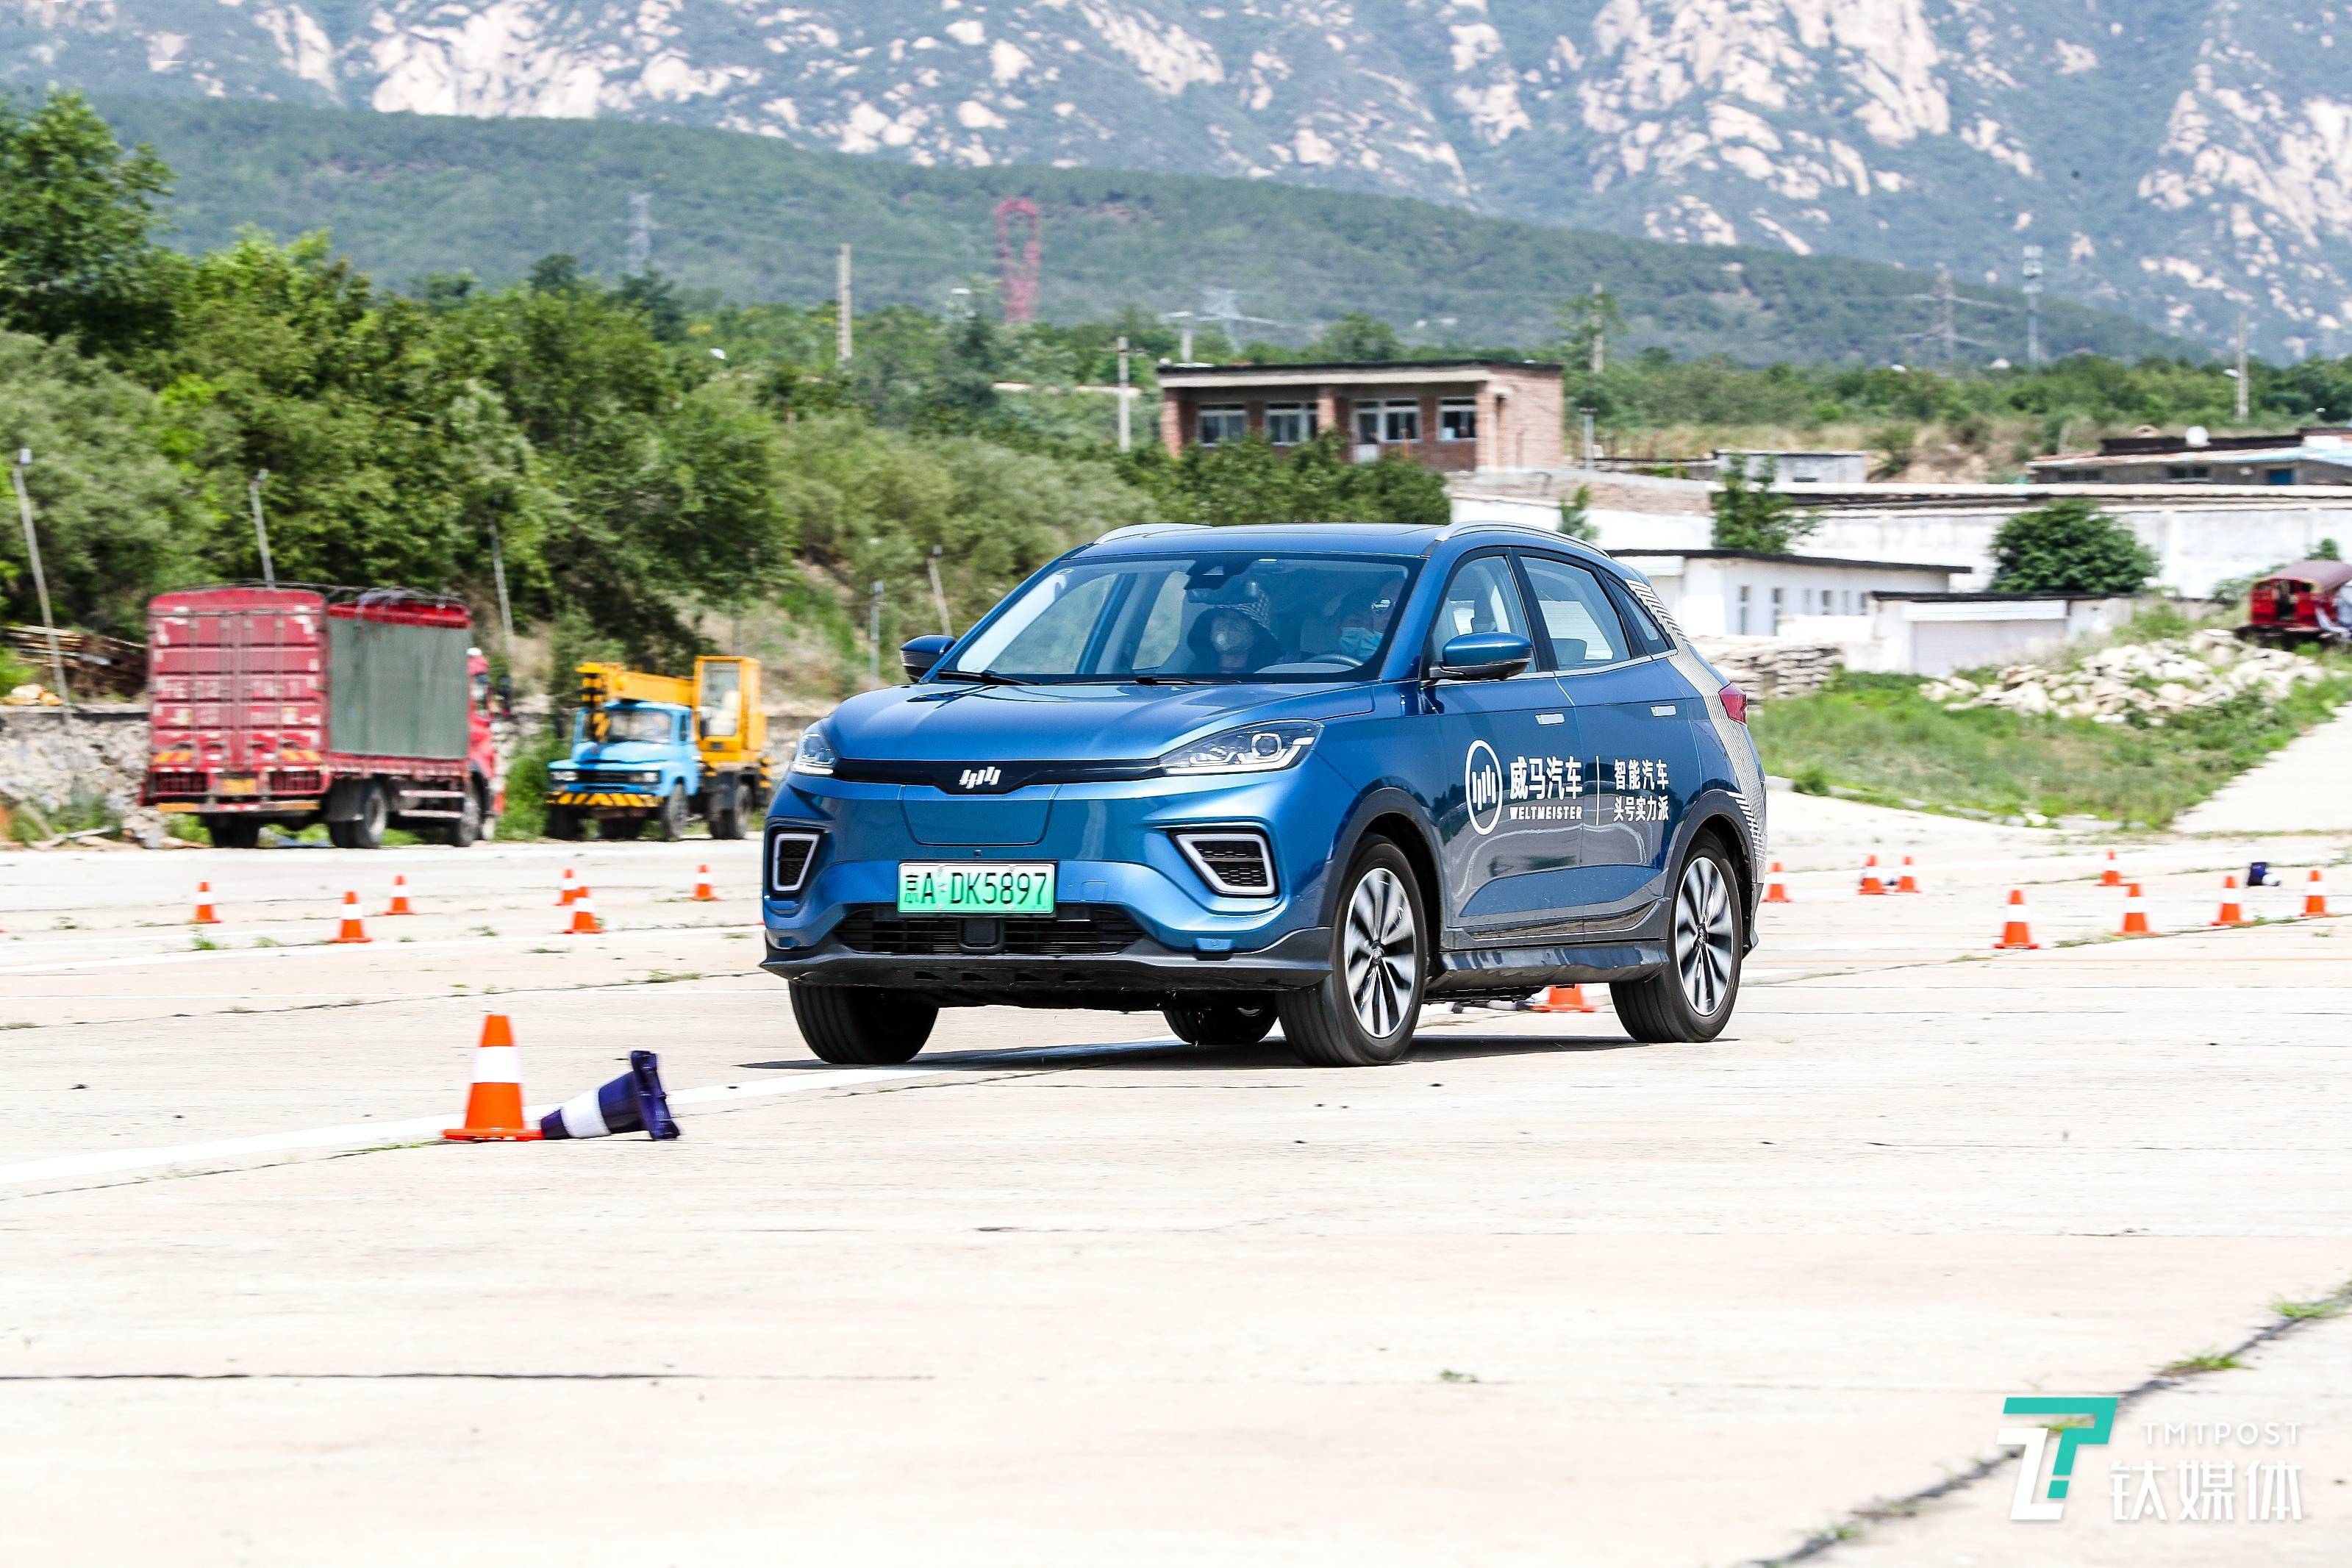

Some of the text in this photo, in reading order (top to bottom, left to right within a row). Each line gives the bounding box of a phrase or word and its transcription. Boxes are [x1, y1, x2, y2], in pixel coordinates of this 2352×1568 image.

[1509, 755, 1583, 800] 威马汽车
[1614, 759, 1669, 790] 智能汽车
[1509, 806, 1582, 820] WELTMEISTER
[1613, 795, 1669, 821] 头号实力派
